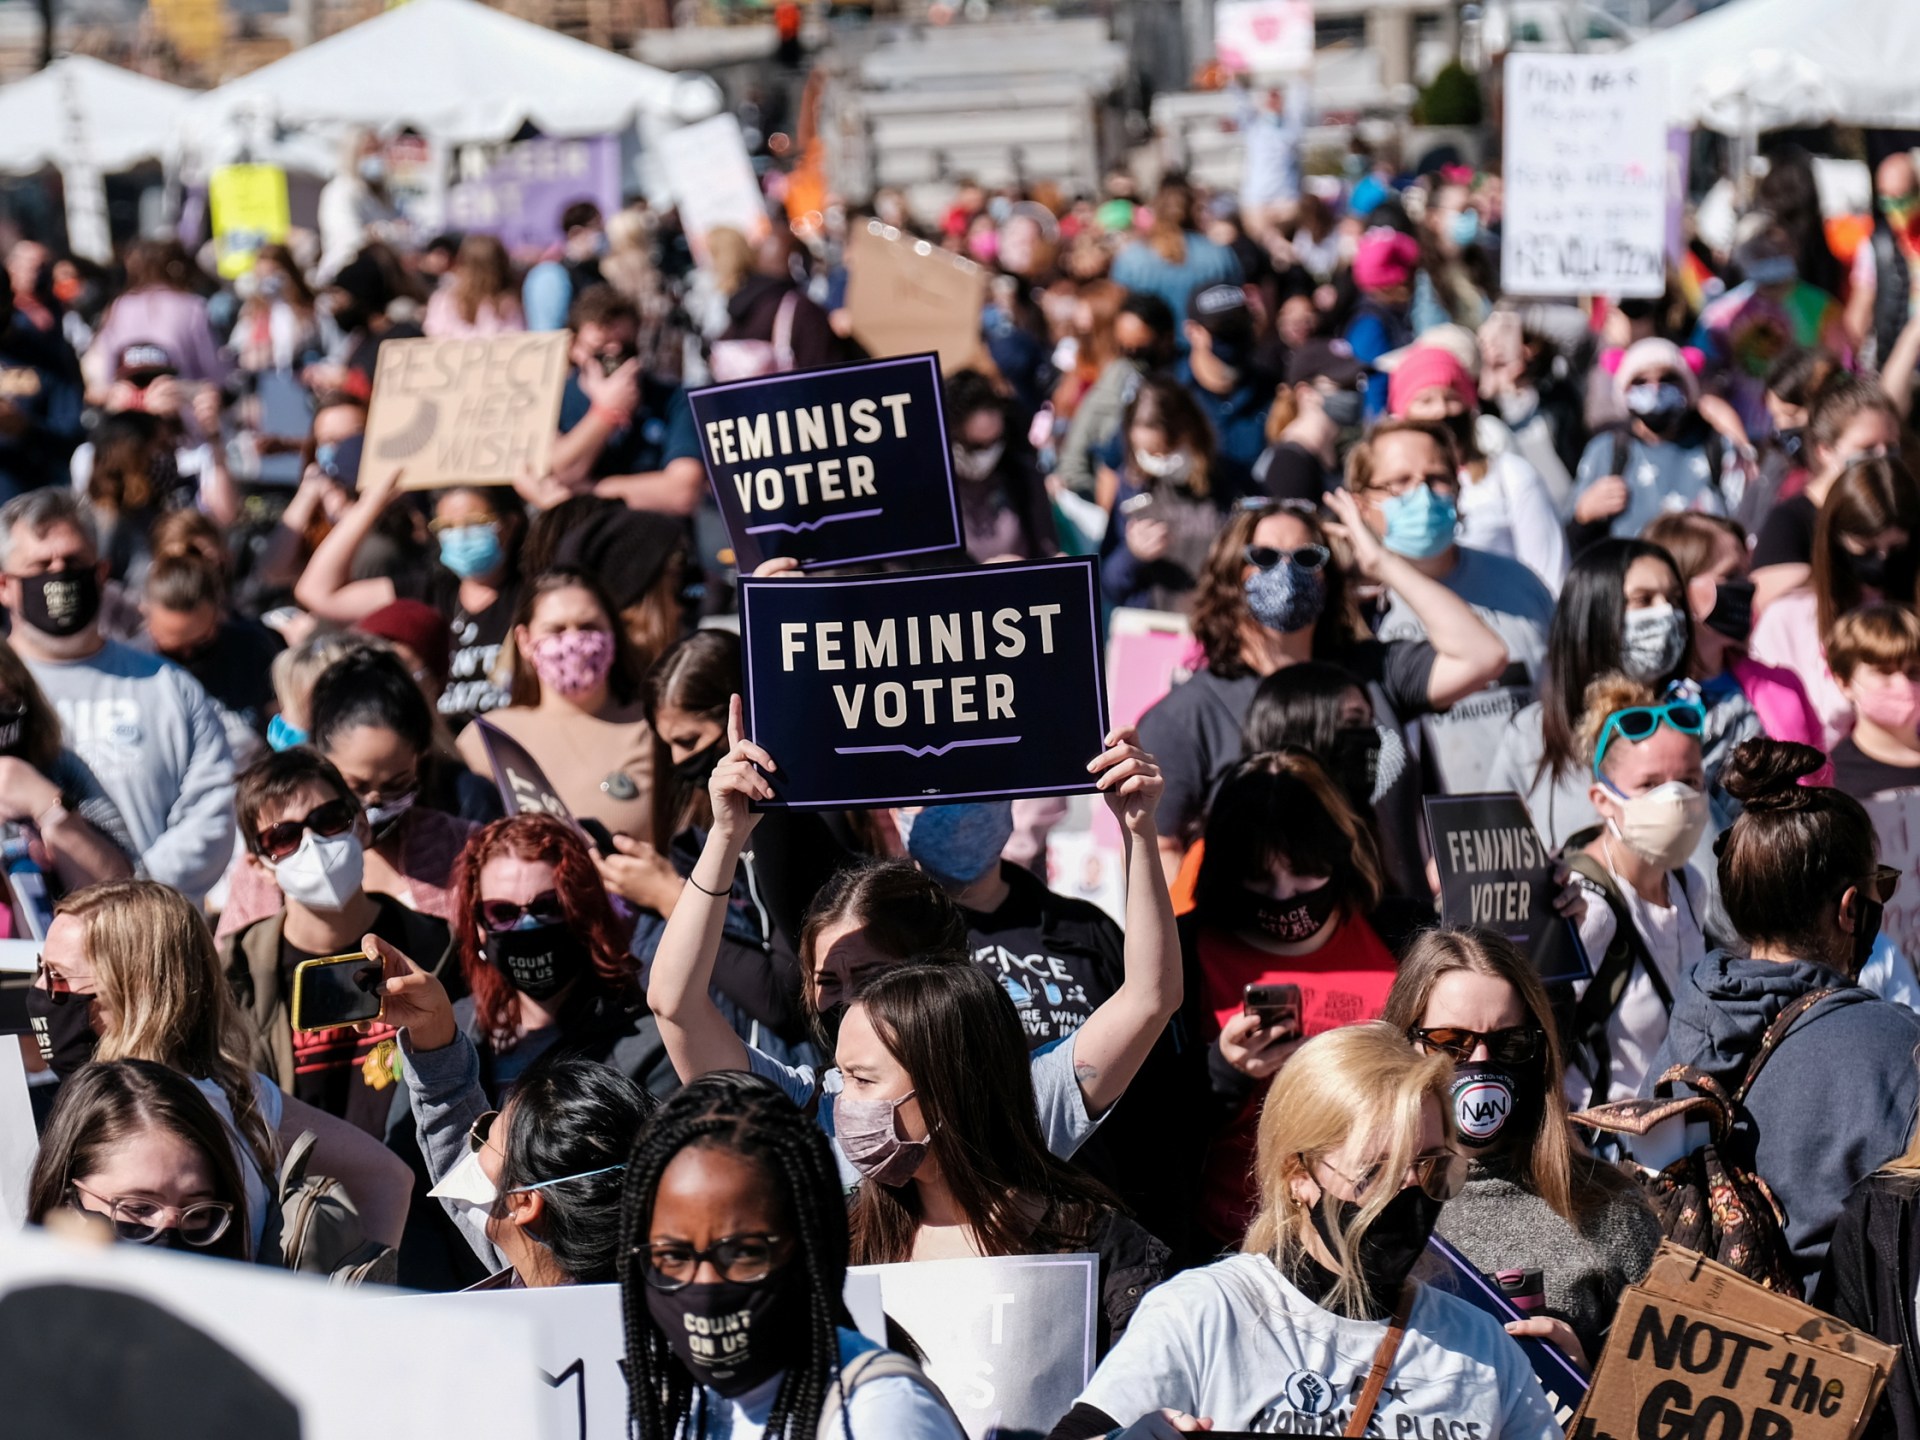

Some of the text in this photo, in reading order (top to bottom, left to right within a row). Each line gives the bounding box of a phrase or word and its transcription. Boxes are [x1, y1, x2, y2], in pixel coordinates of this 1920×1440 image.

[377, 336, 563, 398] RESPECT
[453, 389, 539, 432] HER
[705, 392, 912, 466] FEMINIST
[436, 430, 541, 474] WISH
[733, 454, 878, 514] VOTER
[780, 603, 1061, 672] FEMINIST
[832, 673, 1017, 729] VOTER
[1446, 826, 1546, 873] FEMINIST
[1470, 880, 1531, 923] VOTER
[508, 950, 553, 969] COUNT
[513, 966, 554, 980] ON US
[35, 1032, 52, 1048] US
[1448, 1075, 1474, 1096] NATIONAL
[1462, 1096, 1506, 1122] NAN
[683, 1309, 752, 1336] COUNT
[688, 1332, 749, 1356] ON US
[1627, 1304, 1845, 1418] NOT the
[1395, 1412, 1482, 1440] PLACE
